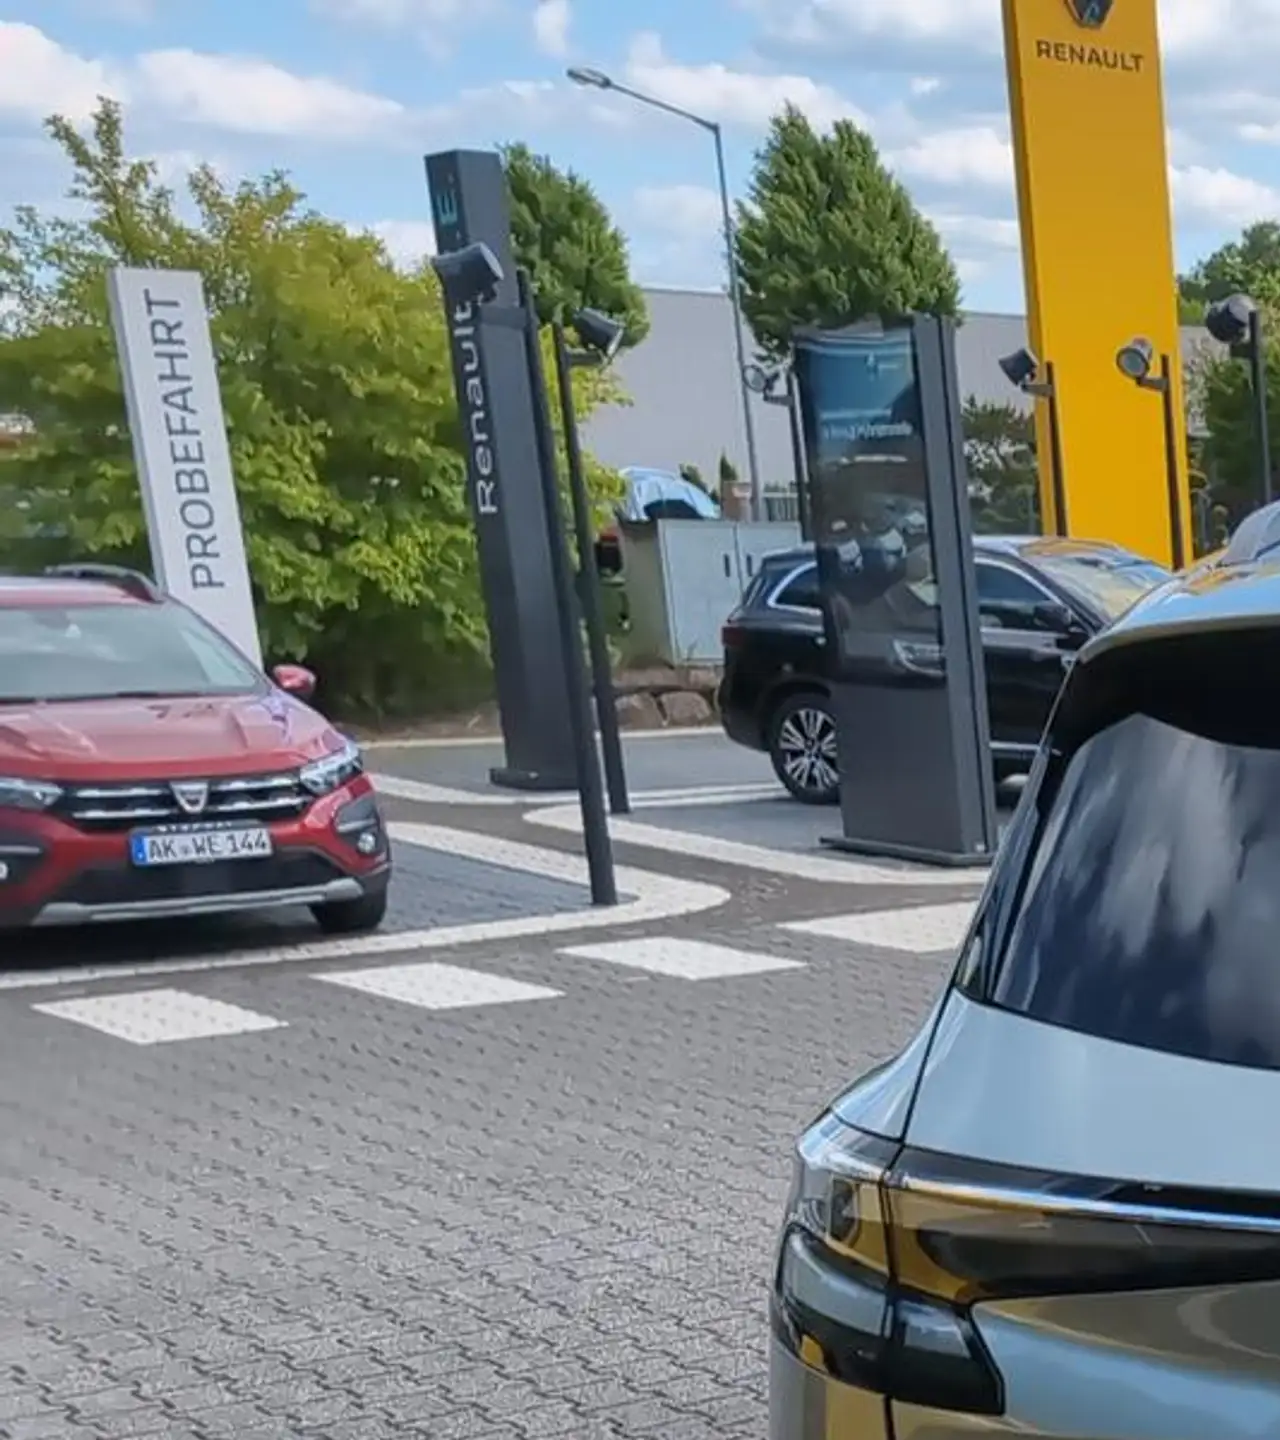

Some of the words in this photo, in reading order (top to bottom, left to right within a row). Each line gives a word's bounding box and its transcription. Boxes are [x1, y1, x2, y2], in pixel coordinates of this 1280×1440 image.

[1035, 39, 1145, 73] RENAULT
[143, 287, 225, 590] PROBEFAHRT
[452, 299, 498, 515] Renault
[226, 832, 267, 853] 144
